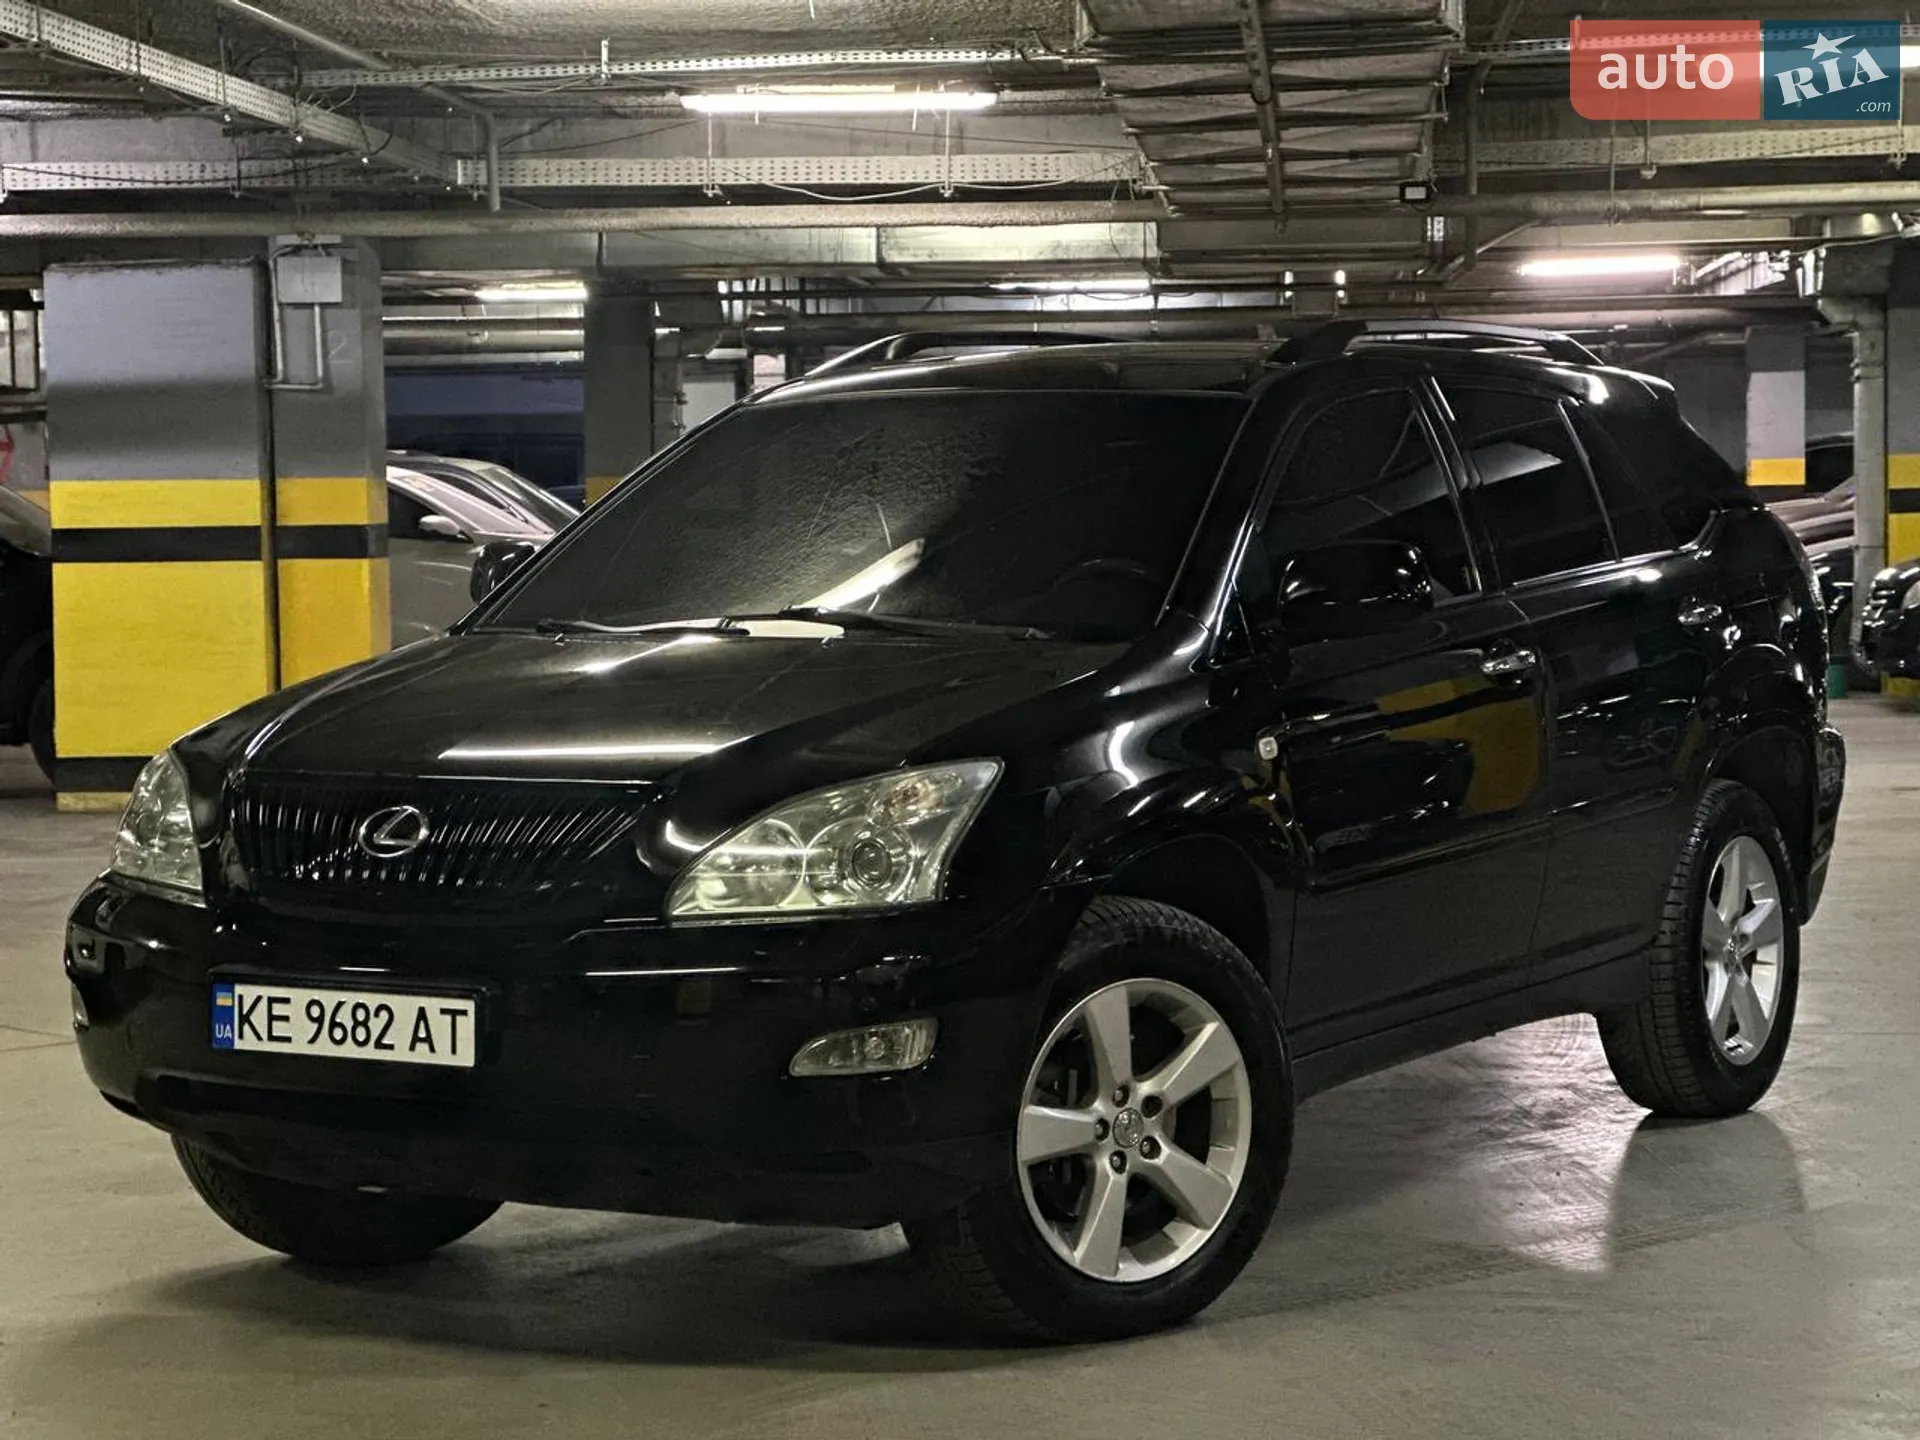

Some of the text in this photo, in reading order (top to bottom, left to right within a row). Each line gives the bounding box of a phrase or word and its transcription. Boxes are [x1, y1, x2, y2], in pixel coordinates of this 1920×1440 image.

[215, 1023, 233, 1039] UA
[237, 993, 469, 1056] KE 9682 AT
